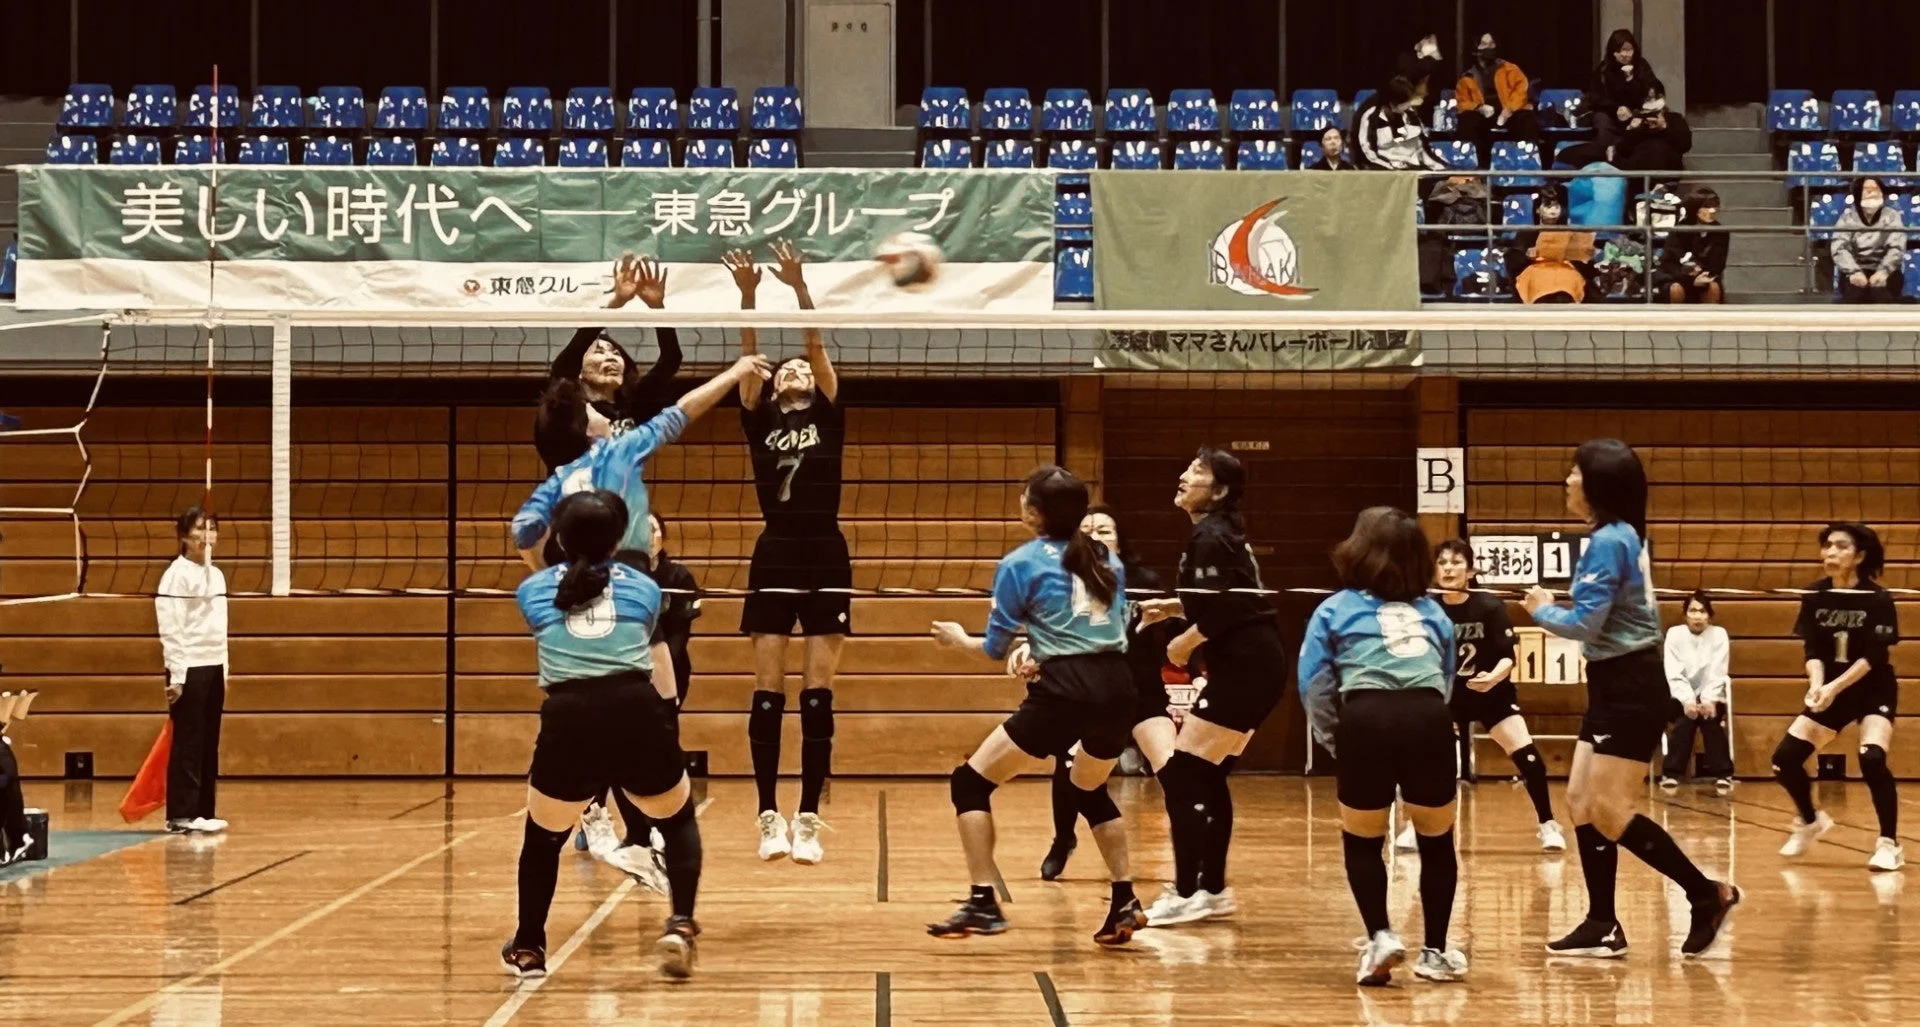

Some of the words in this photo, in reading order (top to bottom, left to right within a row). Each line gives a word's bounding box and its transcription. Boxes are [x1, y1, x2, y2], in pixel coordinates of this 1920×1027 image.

[776, 452, 804, 502] 7
[1422, 457, 1455, 494] B
[1551, 546, 1562, 573] 1
[1456, 643, 1477, 677] 2
[1833, 630, 1849, 663] 1
[1526, 651, 1536, 680] 1
[1555, 653, 1566, 681] 1
